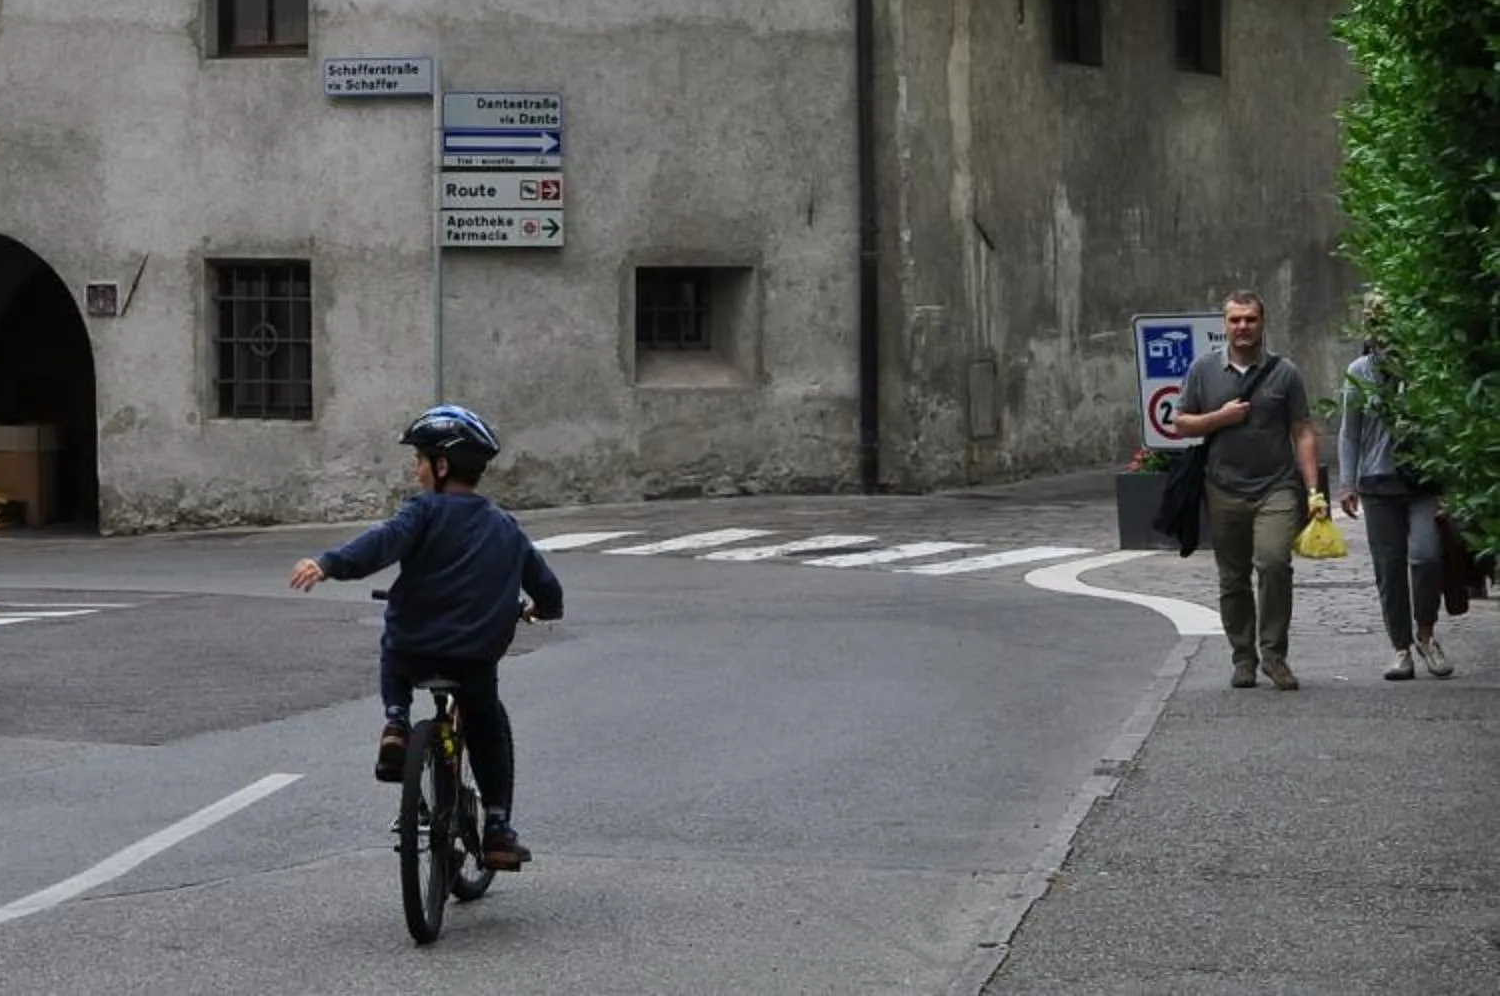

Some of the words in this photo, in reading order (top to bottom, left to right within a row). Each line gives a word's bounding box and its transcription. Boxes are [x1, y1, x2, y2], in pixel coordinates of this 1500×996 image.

[328, 63, 419, 76] Schafferstraße
[345, 78, 399, 91] Schaffer
[476, 97, 559, 110] Dantestraße
[500, 115, 515, 124] via
[519, 113, 559, 125] Dante
[445, 183, 497, 197] Route
[447, 215, 514, 228] Apotheke
[447, 230, 508, 241] farmacia
